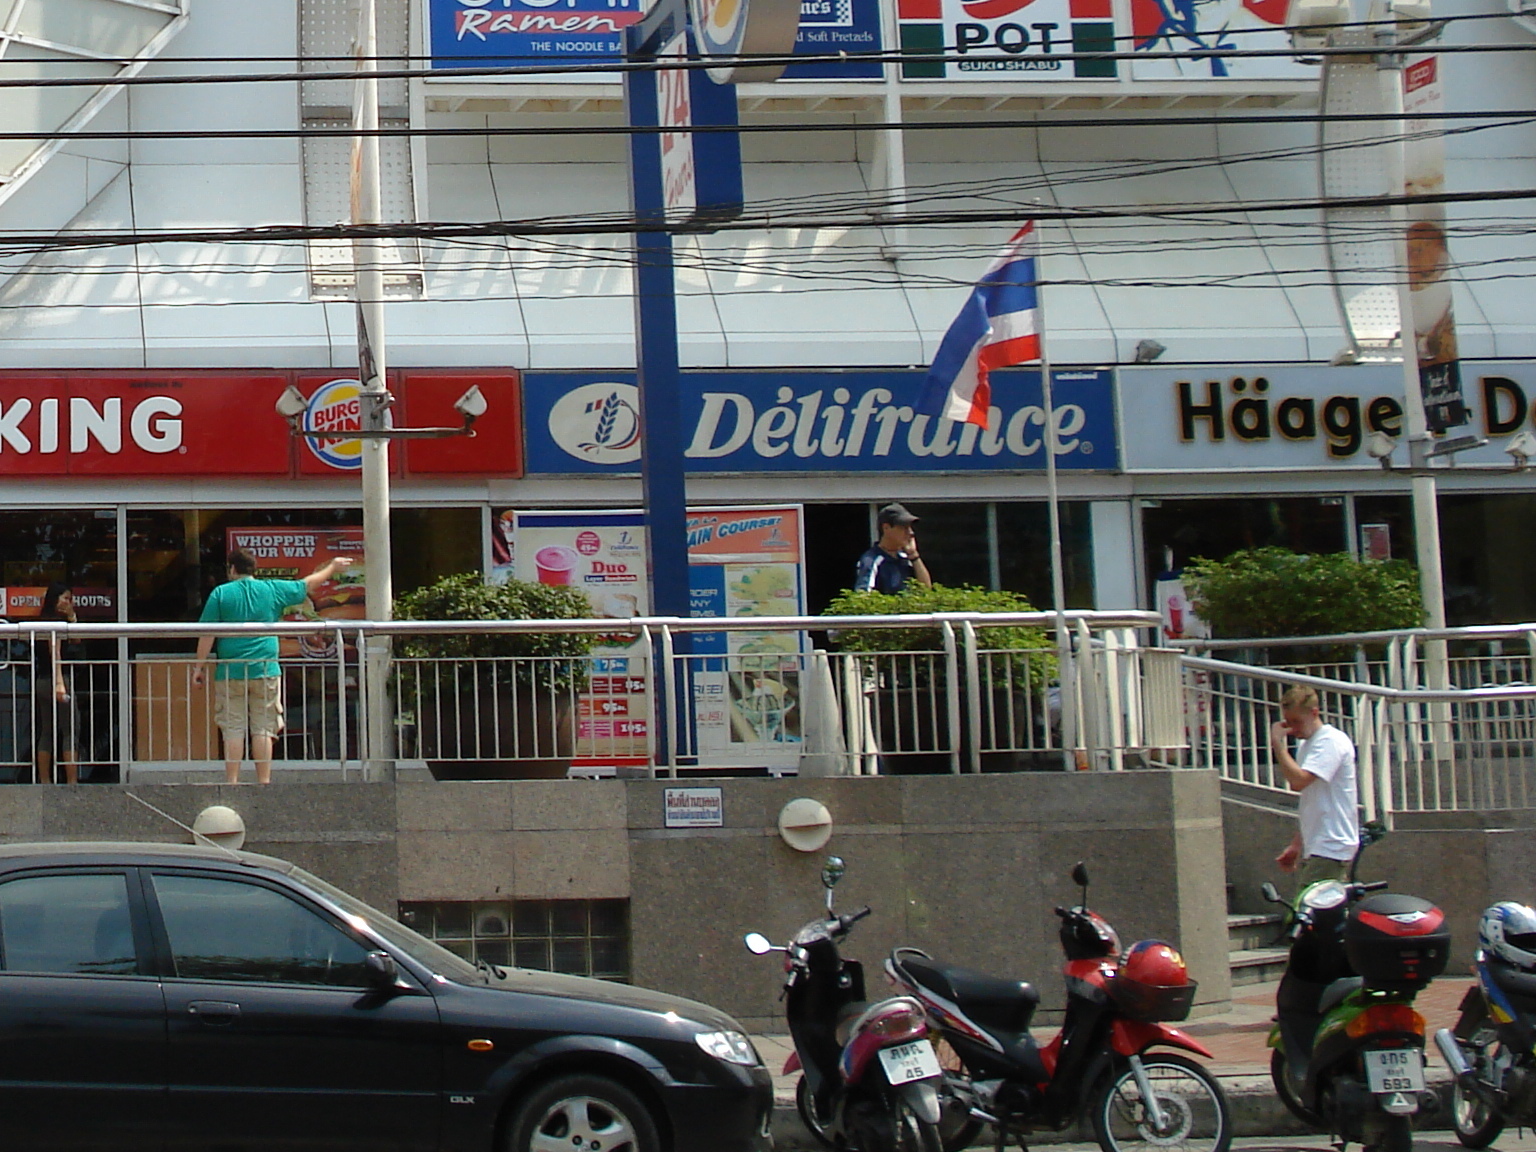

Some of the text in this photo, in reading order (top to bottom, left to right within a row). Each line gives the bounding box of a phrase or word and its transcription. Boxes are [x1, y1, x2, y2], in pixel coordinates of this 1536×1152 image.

[456, 8, 624, 42] Ramen
[807, 30, 829, 42] Soft
[831, 30, 874, 42] Pretzels
[955, 22, 1060, 55] POT
[530, 41, 551, 52] THE
[555, 41, 605, 53] NOODLE
[314, 400, 360, 428] BURG
[236, 535, 316, 547] WHOPPER
[250, 547, 316, 558] OUR WAY
[591, 561, 628, 574] Duo
[10, 595, 112, 608] OPEN HOURS
